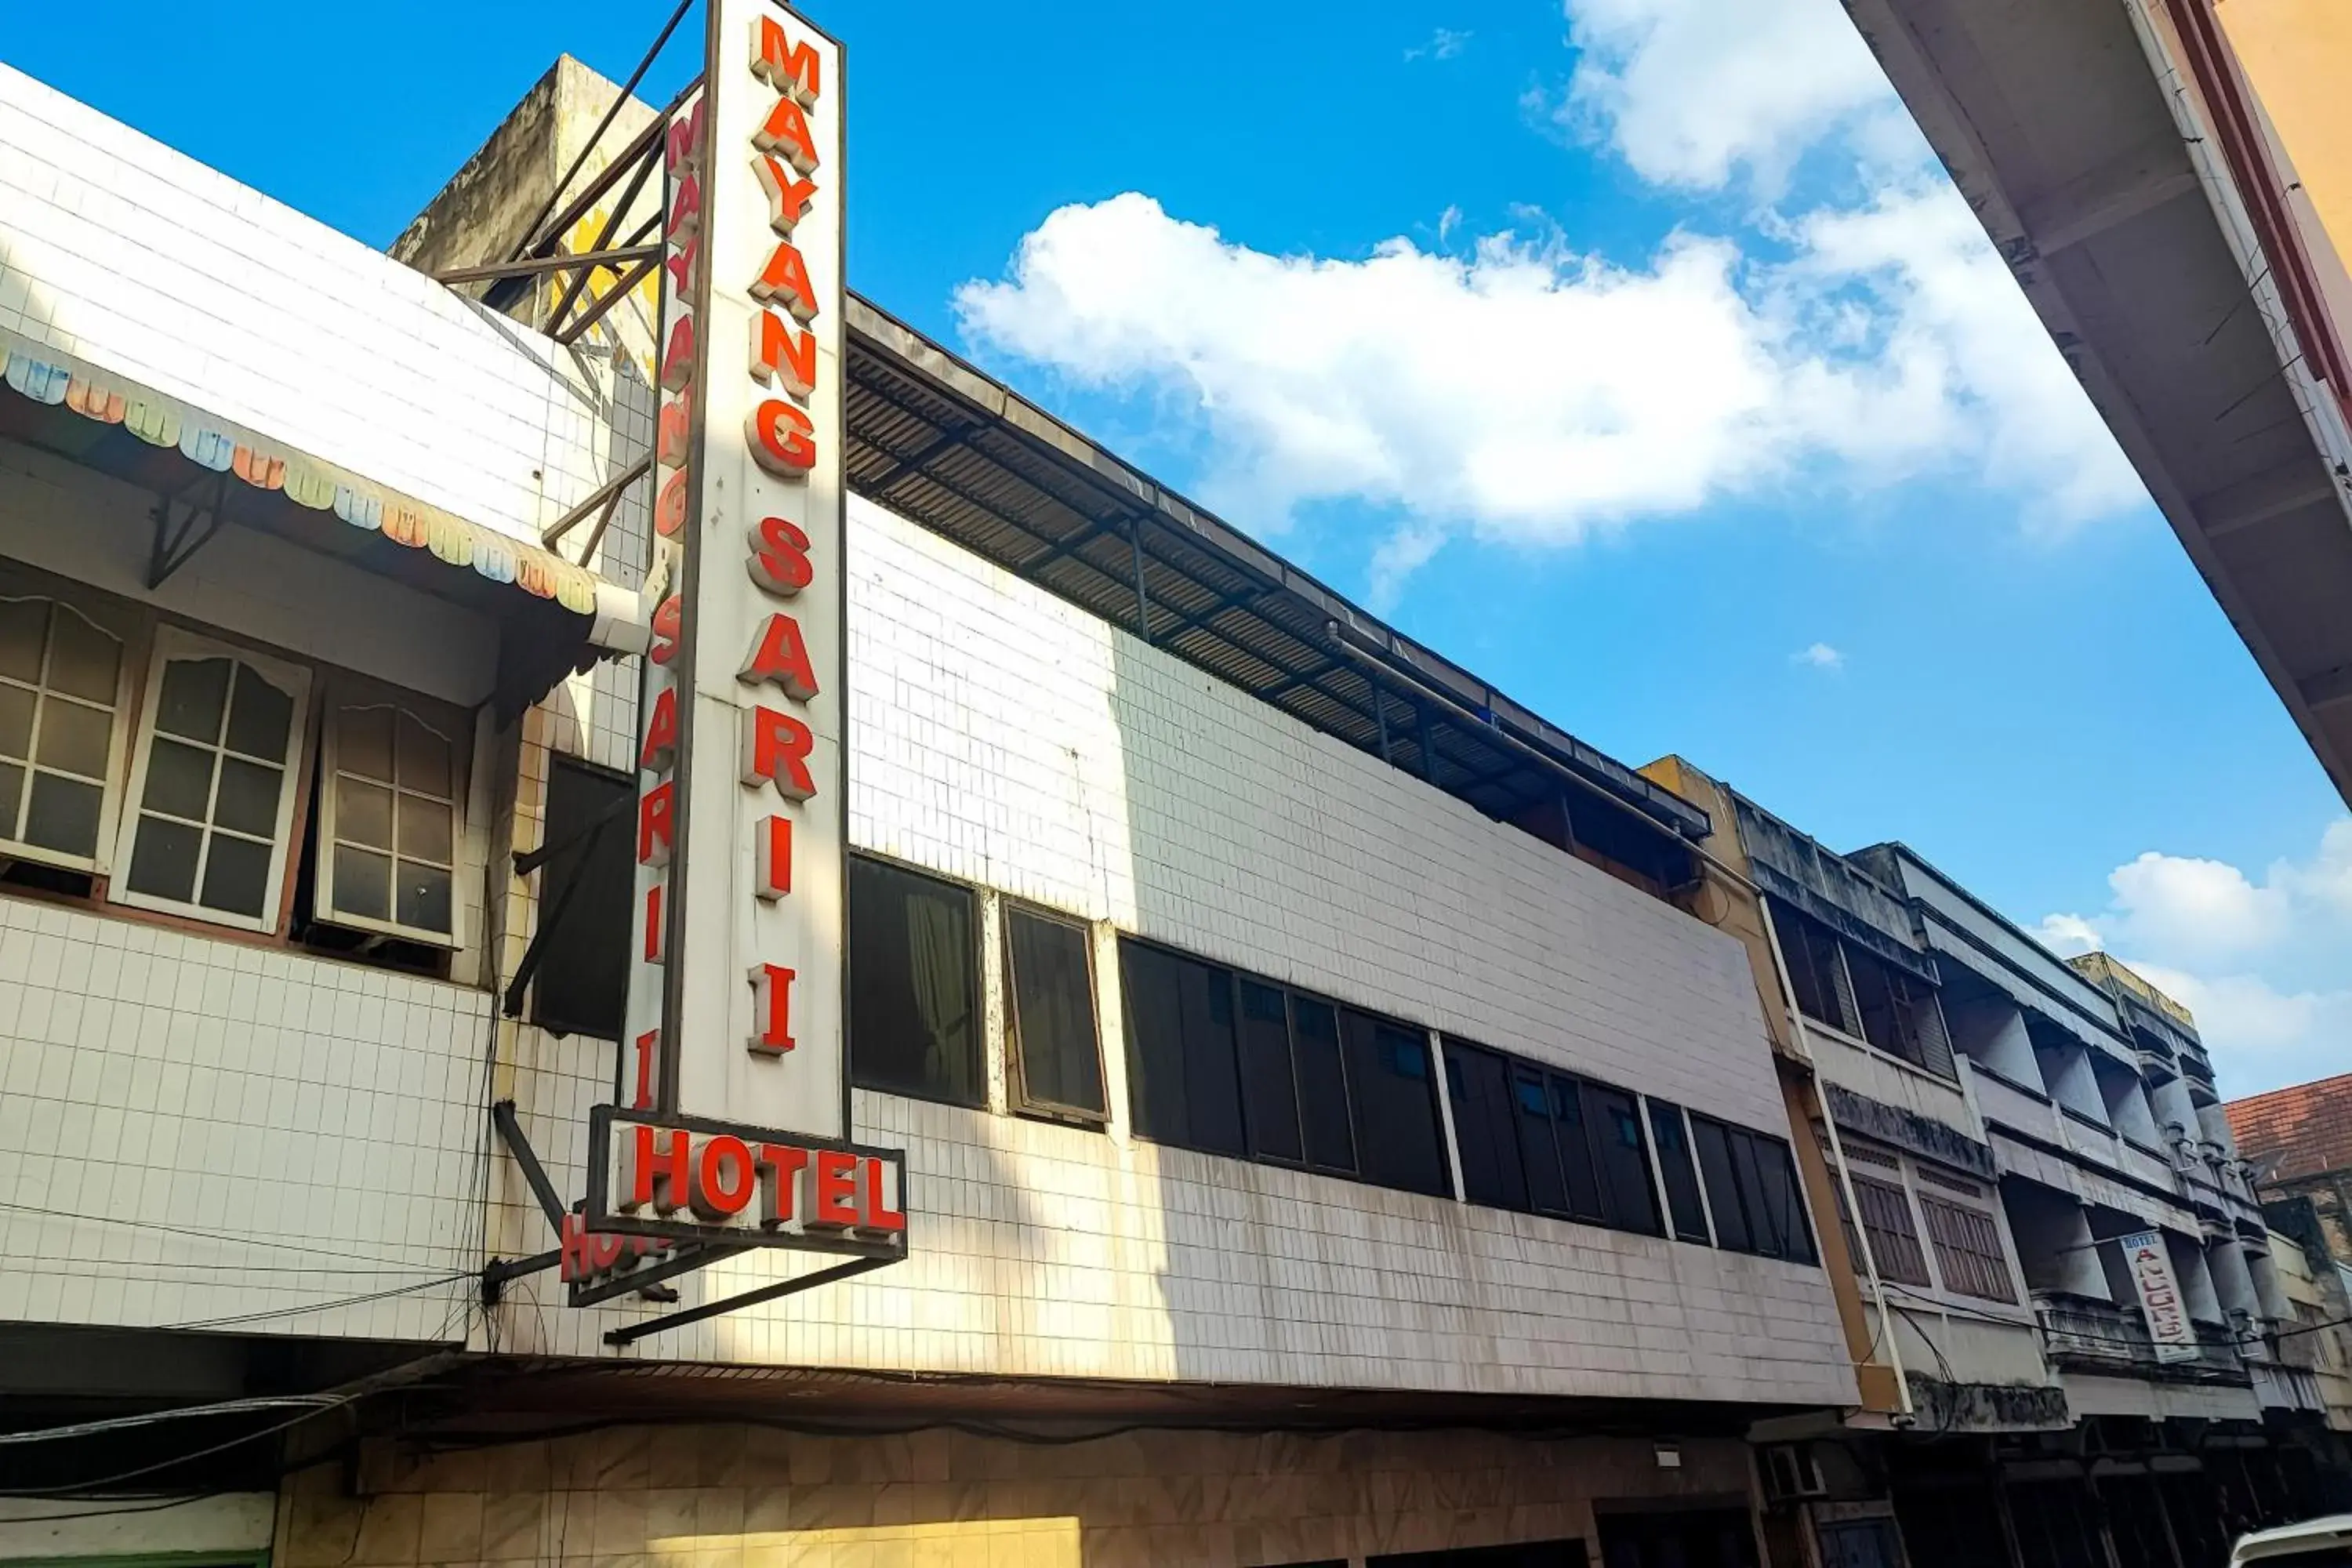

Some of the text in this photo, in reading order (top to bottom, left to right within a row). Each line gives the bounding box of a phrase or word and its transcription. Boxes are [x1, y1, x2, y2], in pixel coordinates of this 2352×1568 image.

[655, 96, 704, 536] MAYANG
[745, 13, 820, 476] MAYANG
[619, 1124, 906, 1233] HOTEL
